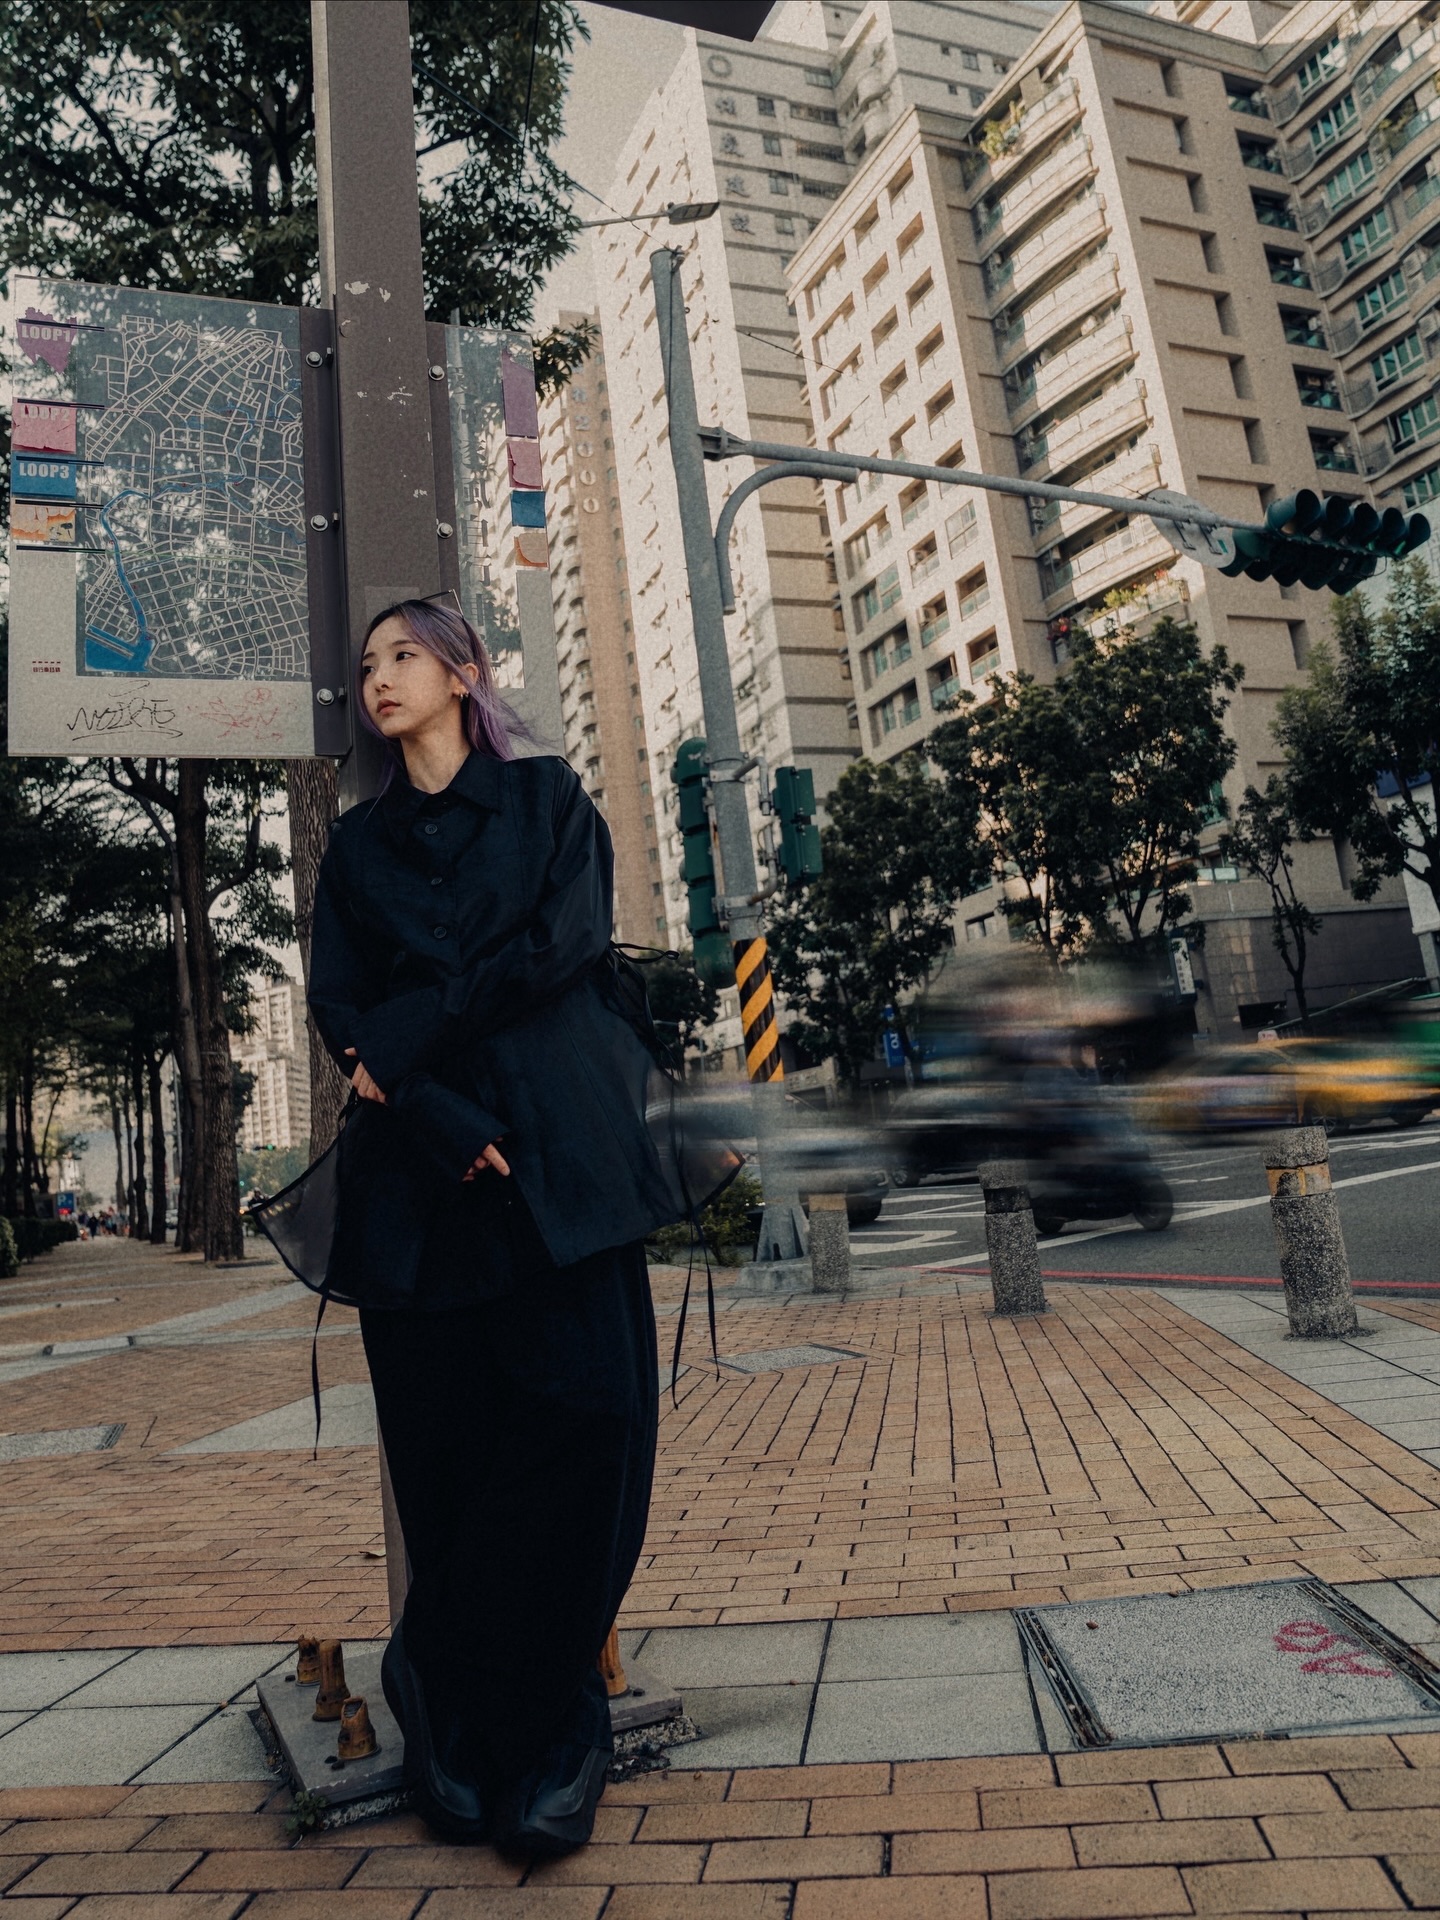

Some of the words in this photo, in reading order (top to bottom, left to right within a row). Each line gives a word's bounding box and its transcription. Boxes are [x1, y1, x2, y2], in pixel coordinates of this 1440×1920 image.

[21, 325, 71, 342] LOOP1
[20, 404, 70, 421] LOOP2
[19, 463, 70, 478] LOOP3
